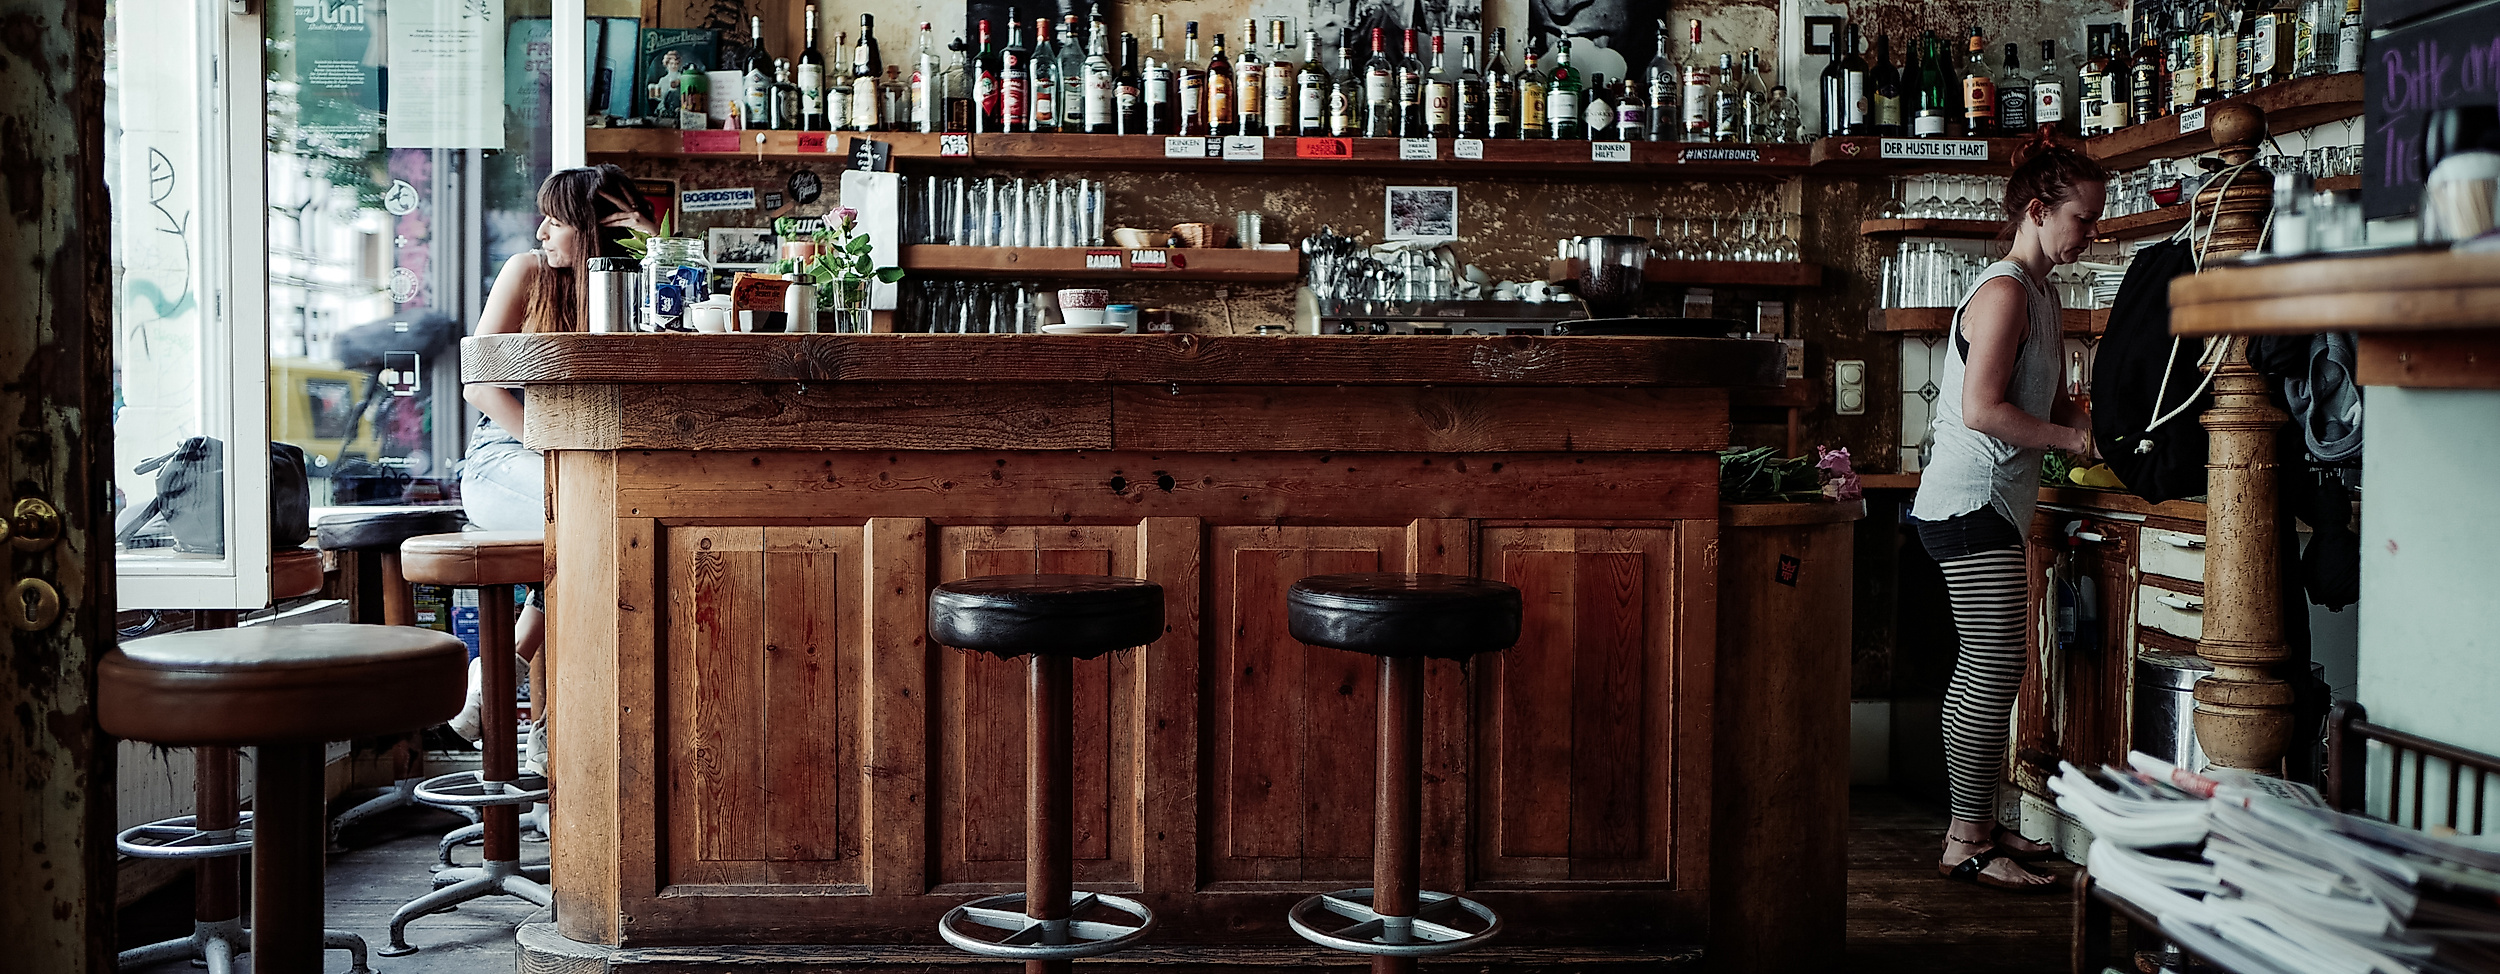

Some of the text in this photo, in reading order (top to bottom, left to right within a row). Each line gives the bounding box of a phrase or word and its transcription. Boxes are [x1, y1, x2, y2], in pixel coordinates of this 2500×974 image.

[304, 0, 364, 24] Juni
[2182, 112, 2202, 122] TRINKEN
[940, 135, 968, 145] FCK
[941, 144, 969, 156] AFD
[1594, 144, 1626, 152] TRINKEN
[1884, 142, 1985, 156] DER HUSTLE IST HART
[1686, 149, 1757, 160] #INSTANTBONER
[1086, 250, 1166, 268] RAMBA ZAMBA
